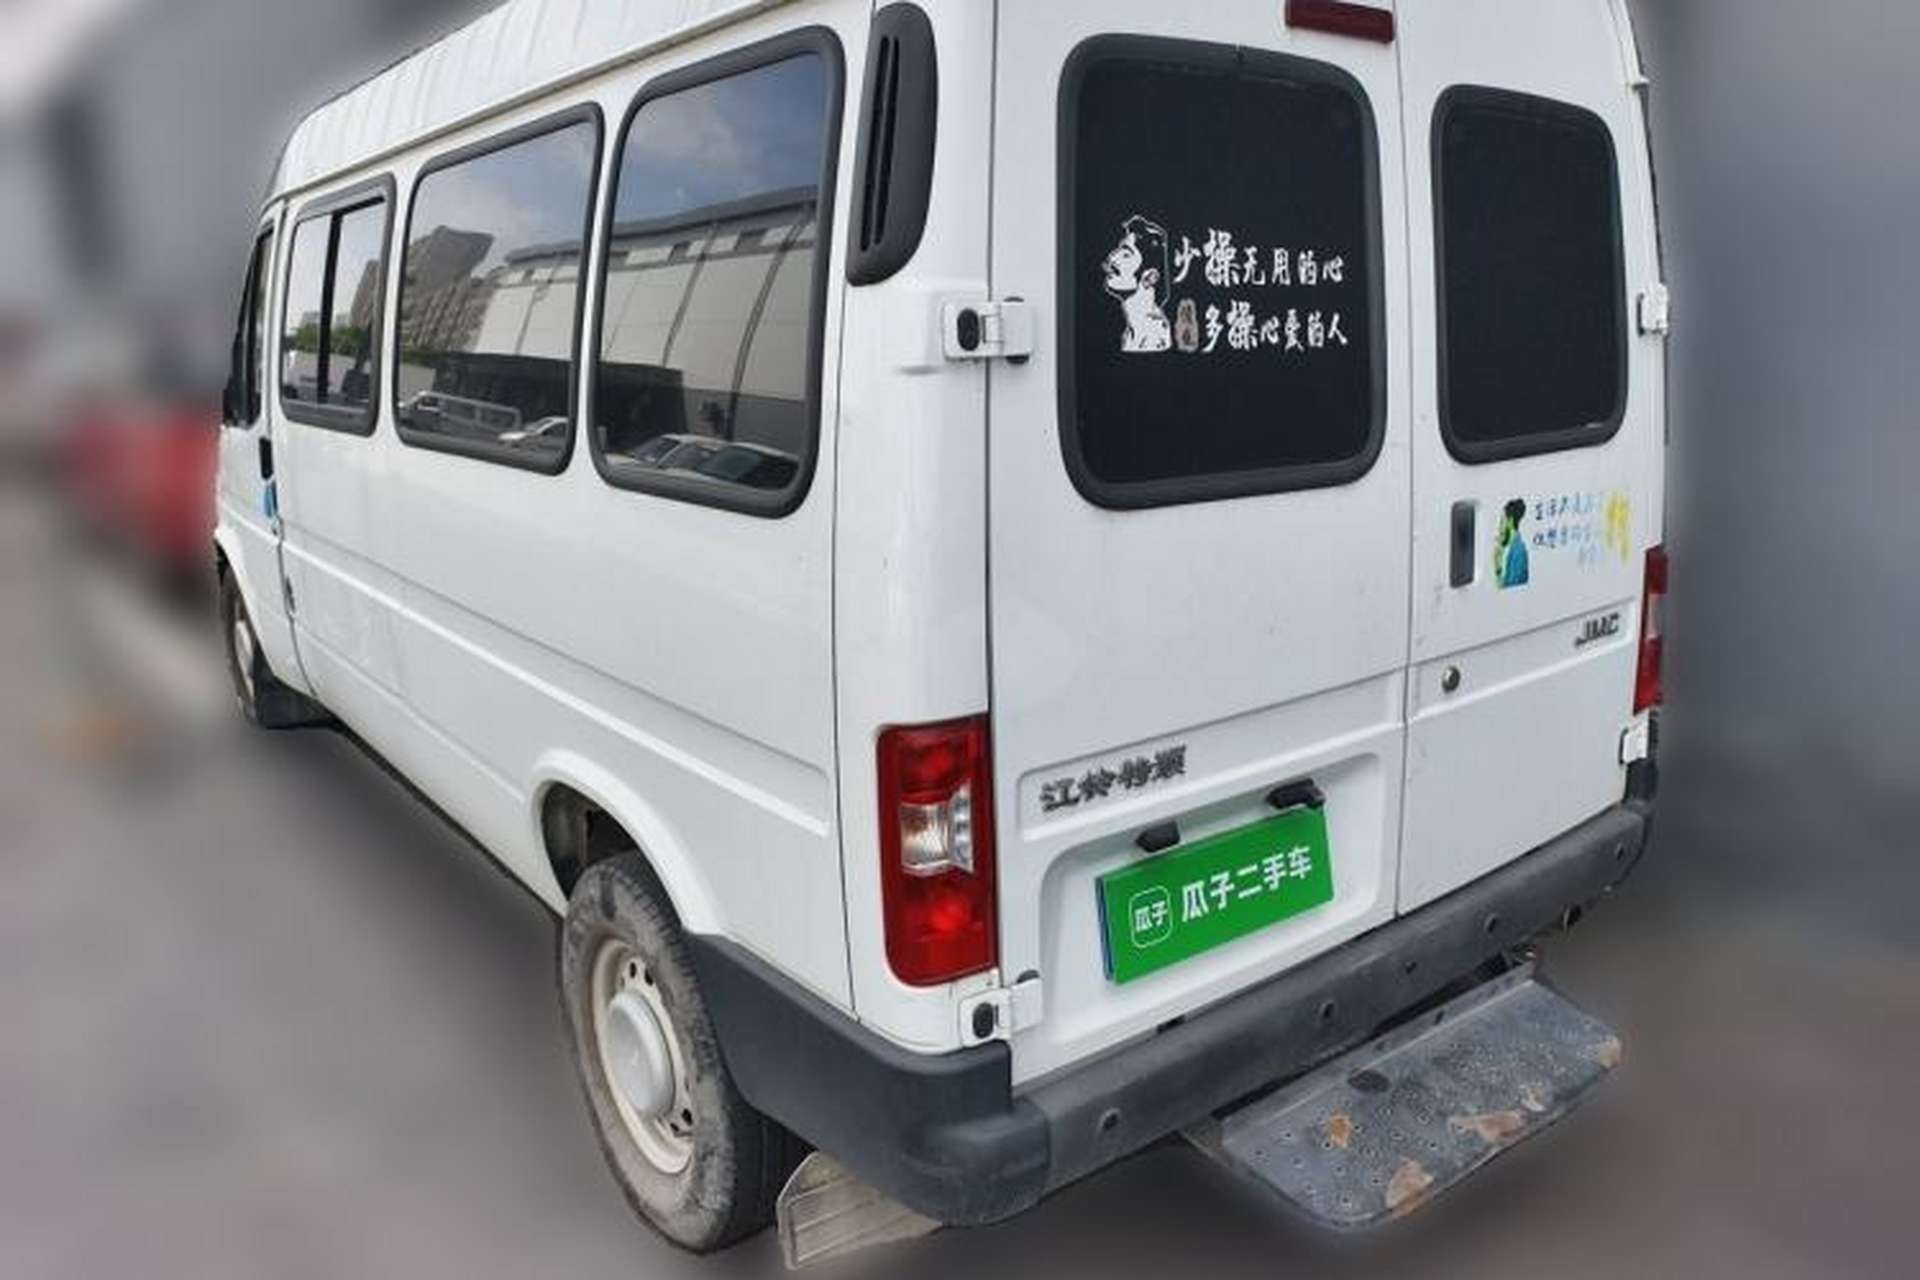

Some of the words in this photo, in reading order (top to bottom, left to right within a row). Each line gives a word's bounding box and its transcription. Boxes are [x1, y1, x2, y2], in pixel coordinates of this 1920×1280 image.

[1173, 227, 1345, 287] 少操无用的心
[1202, 300, 1348, 352] 多操心爱的人
[1574, 612, 1621, 647] JMC
[1182, 846, 1312, 922] 瓜子二手车
[1134, 900, 1169, 932] 瓜子
